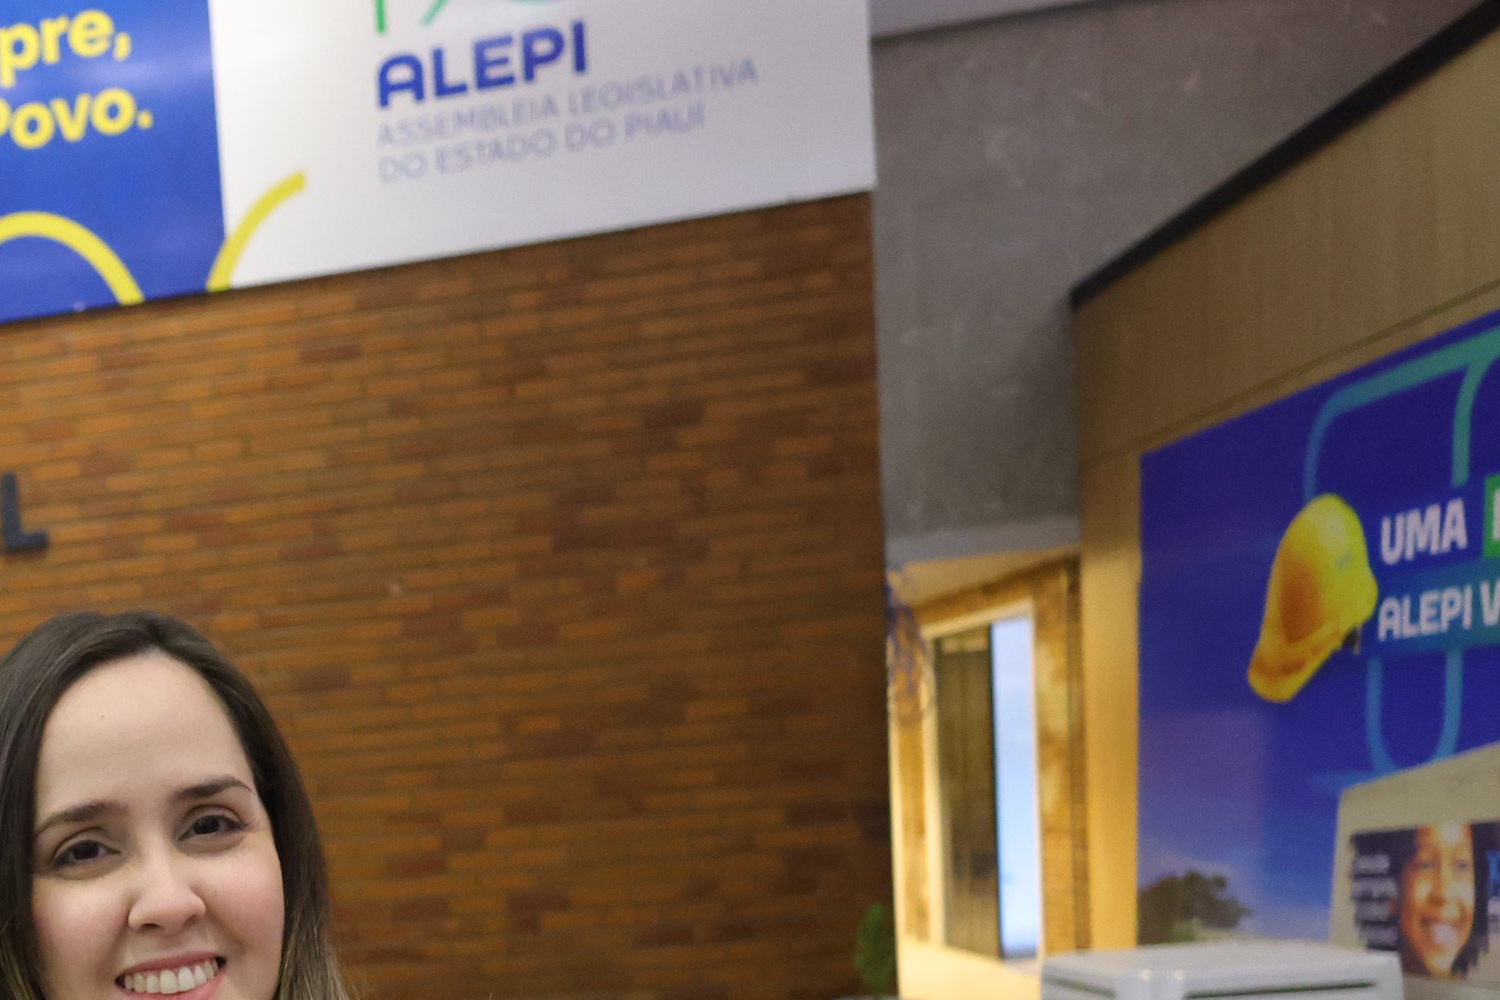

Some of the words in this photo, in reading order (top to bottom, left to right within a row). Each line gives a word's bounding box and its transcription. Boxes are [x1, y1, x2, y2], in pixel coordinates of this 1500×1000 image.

[377, 20, 588, 108] ALEPI
[378, 92, 560, 148] ASSEMBLEIA
[567, 57, 758, 116] LEGISLATIVA
[378, 151, 428, 184] DO
[435, 127, 559, 175] ESTADO
[564, 117, 617, 153] DO
[1381, 497, 1468, 566] UMA
[1378, 584, 1473, 642] ALEPI
